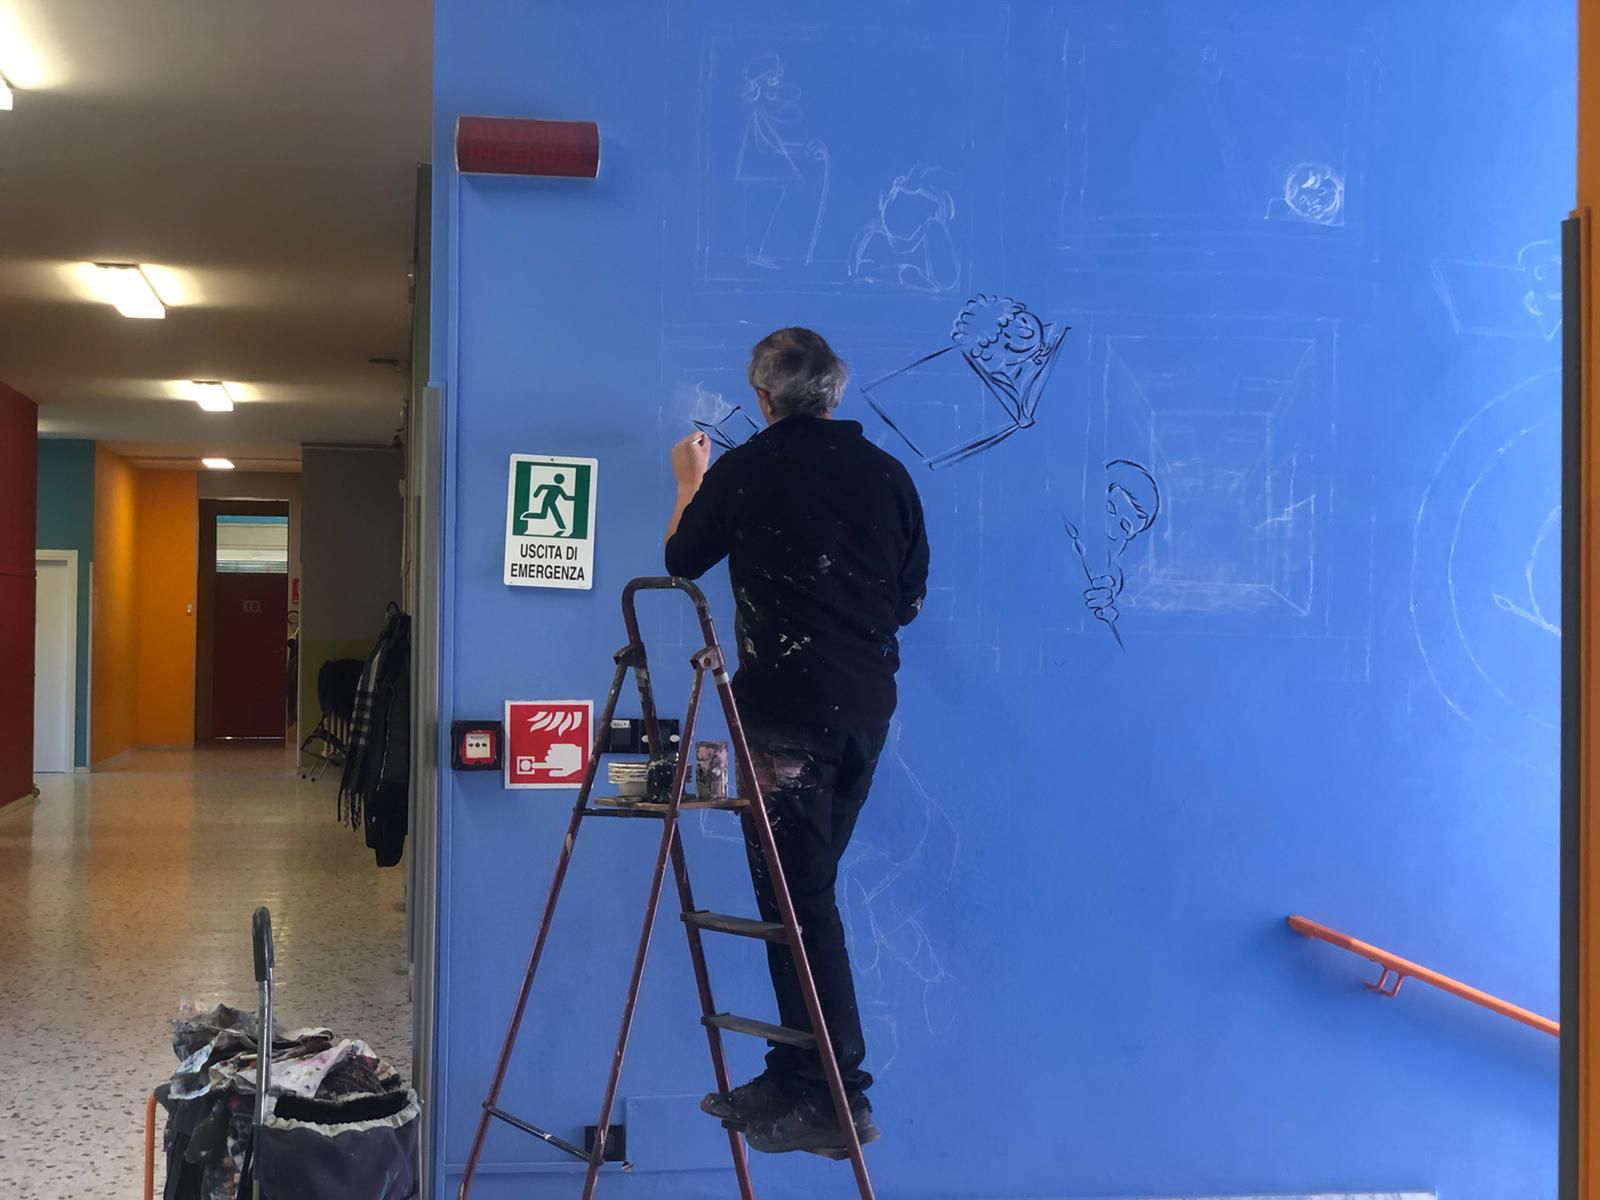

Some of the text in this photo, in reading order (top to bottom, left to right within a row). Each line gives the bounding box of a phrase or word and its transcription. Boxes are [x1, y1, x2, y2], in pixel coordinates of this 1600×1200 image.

[520, 543, 578, 560] USCITA DI
[510, 563, 585, 581] EMERGENZA
